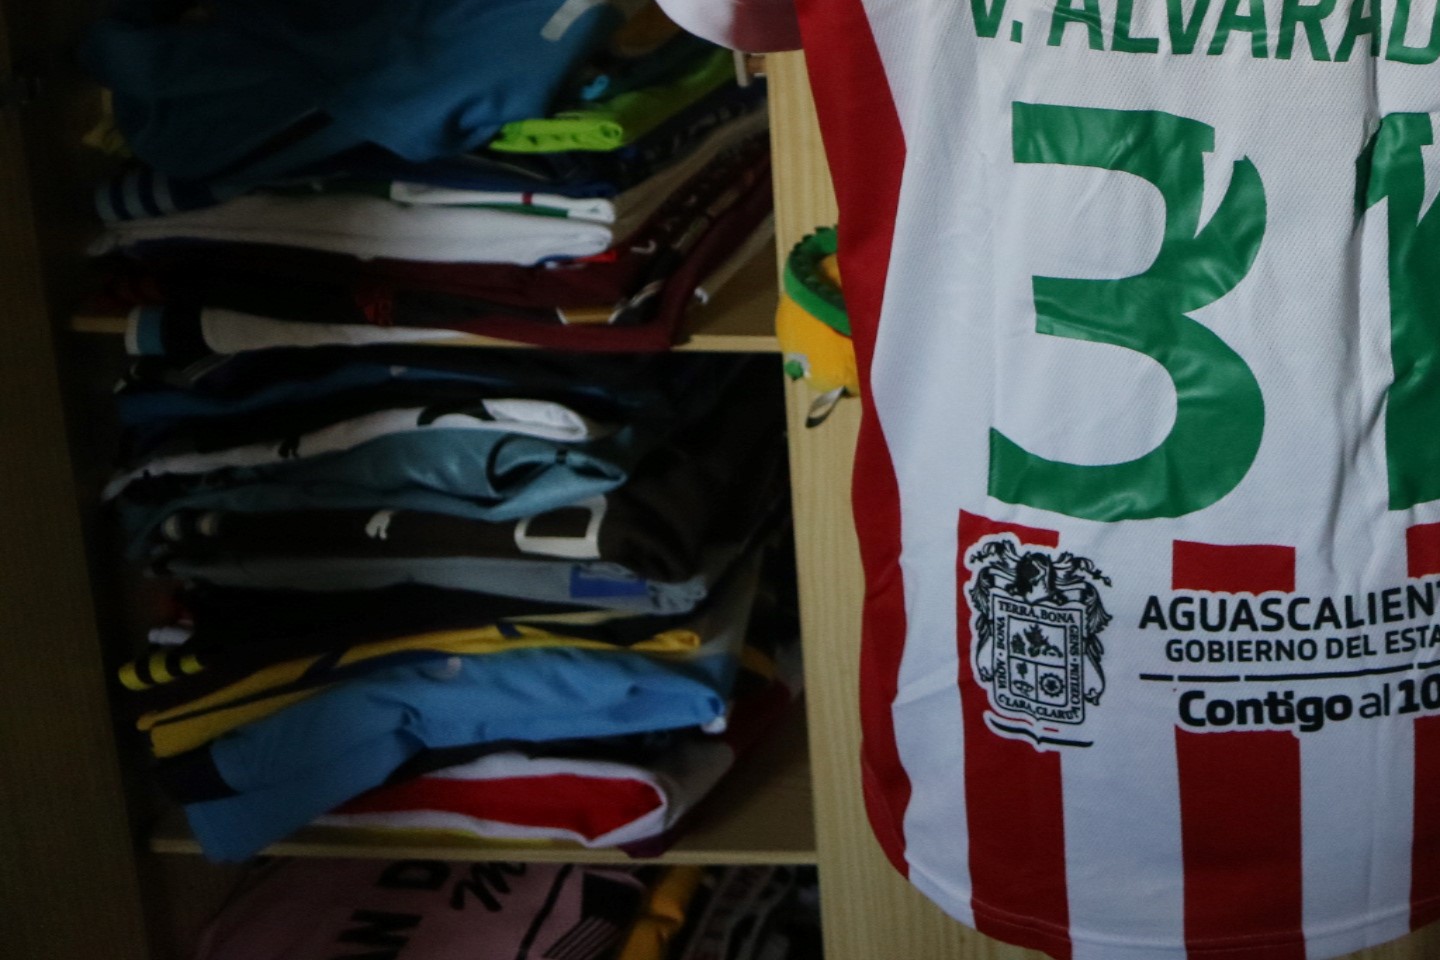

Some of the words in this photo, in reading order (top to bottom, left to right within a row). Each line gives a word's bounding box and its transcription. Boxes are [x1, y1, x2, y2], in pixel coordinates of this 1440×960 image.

[1165, 638, 1318, 664] GOBIERNO
[1325, 633, 1377, 660] DEL
[1178, 690, 1353, 732] Contigo
[1358, 682, 1391, 719] al
